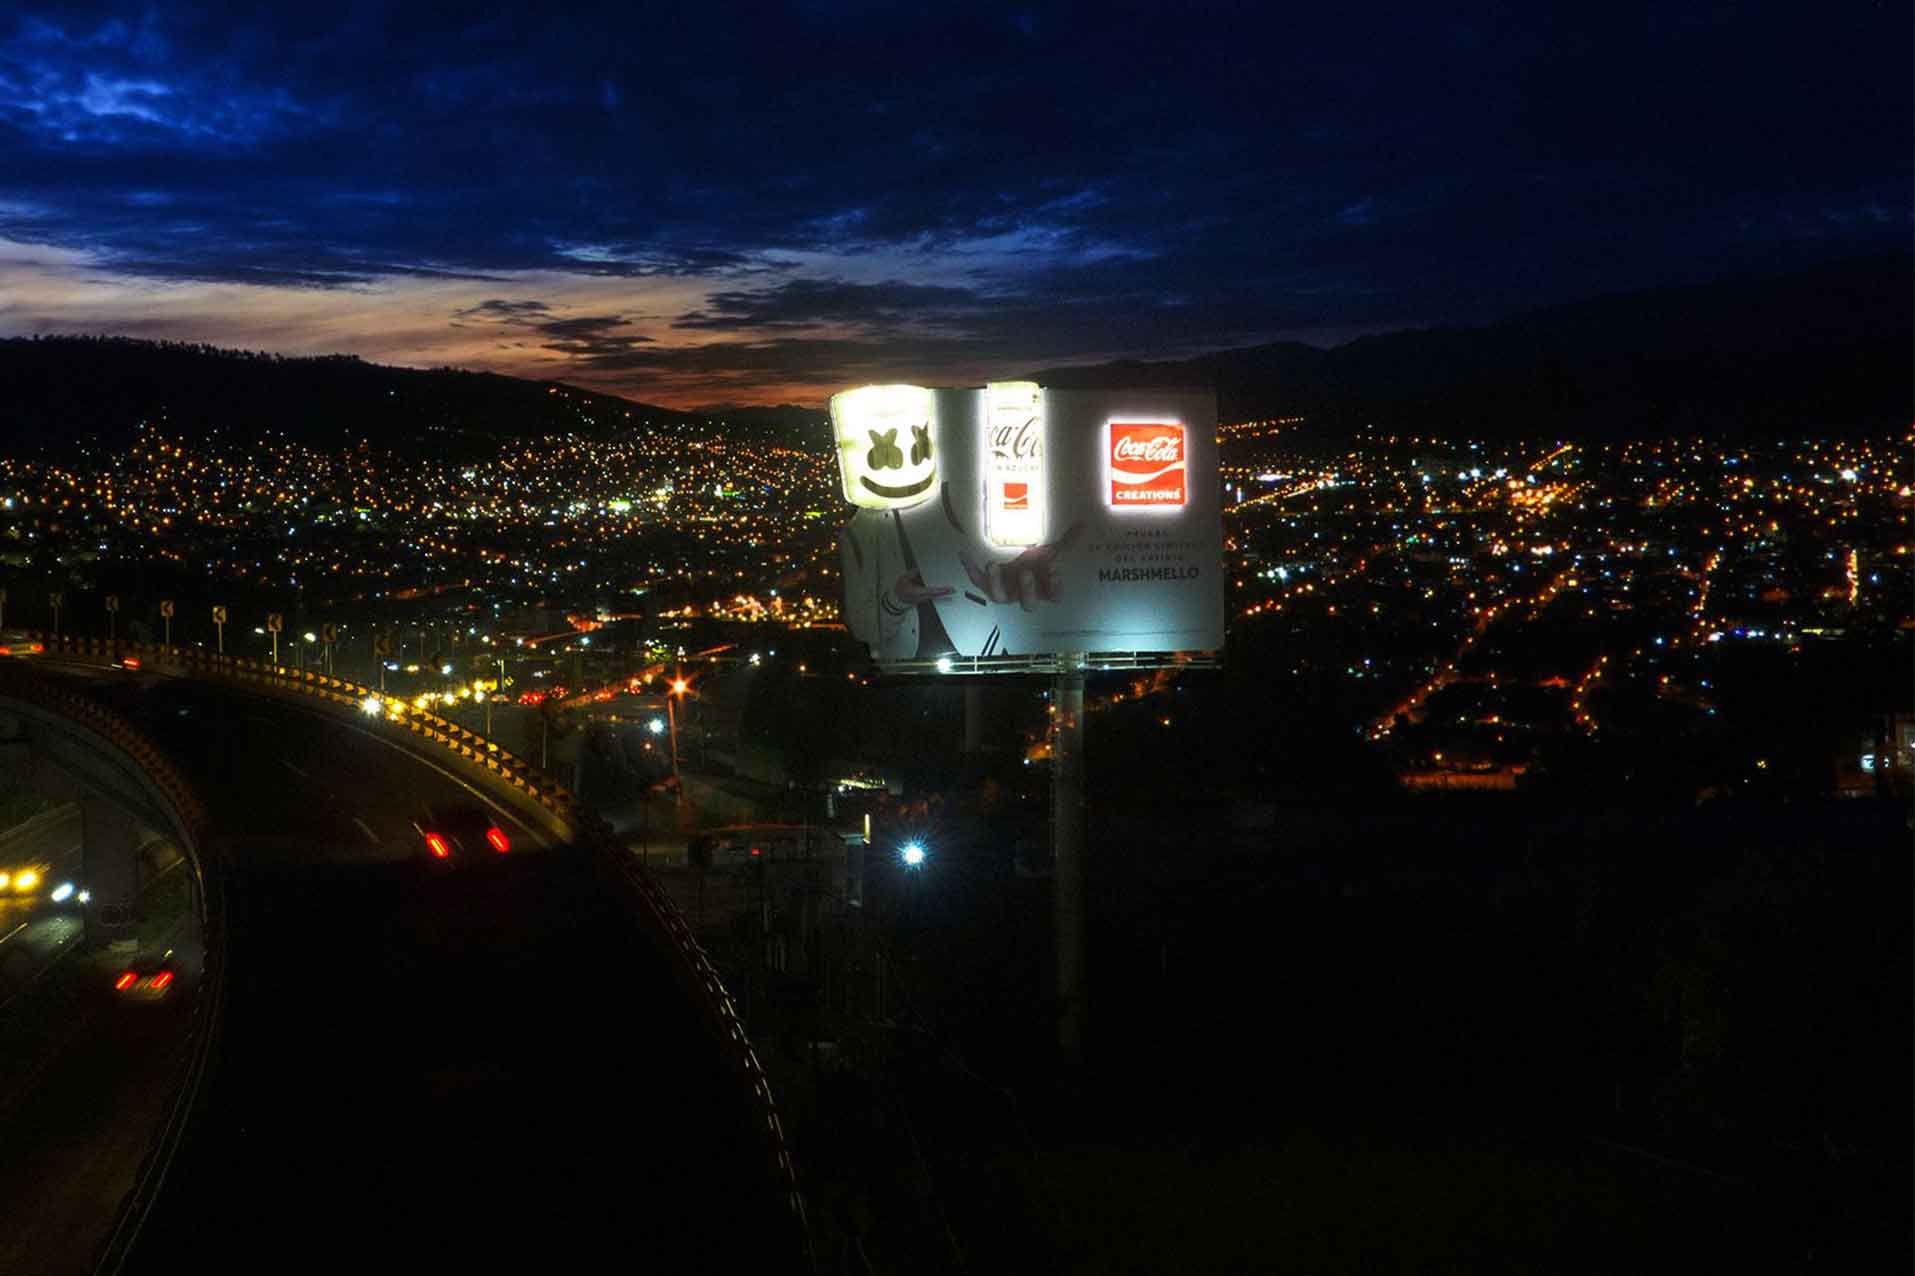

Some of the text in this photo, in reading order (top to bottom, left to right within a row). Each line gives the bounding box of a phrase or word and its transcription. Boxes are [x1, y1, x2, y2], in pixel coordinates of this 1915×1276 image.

[1114, 436, 1182, 462] Coca-Cola
[1116, 488, 1182, 500] CREATIONS
[1098, 567, 1200, 582] MARSHMELLO
